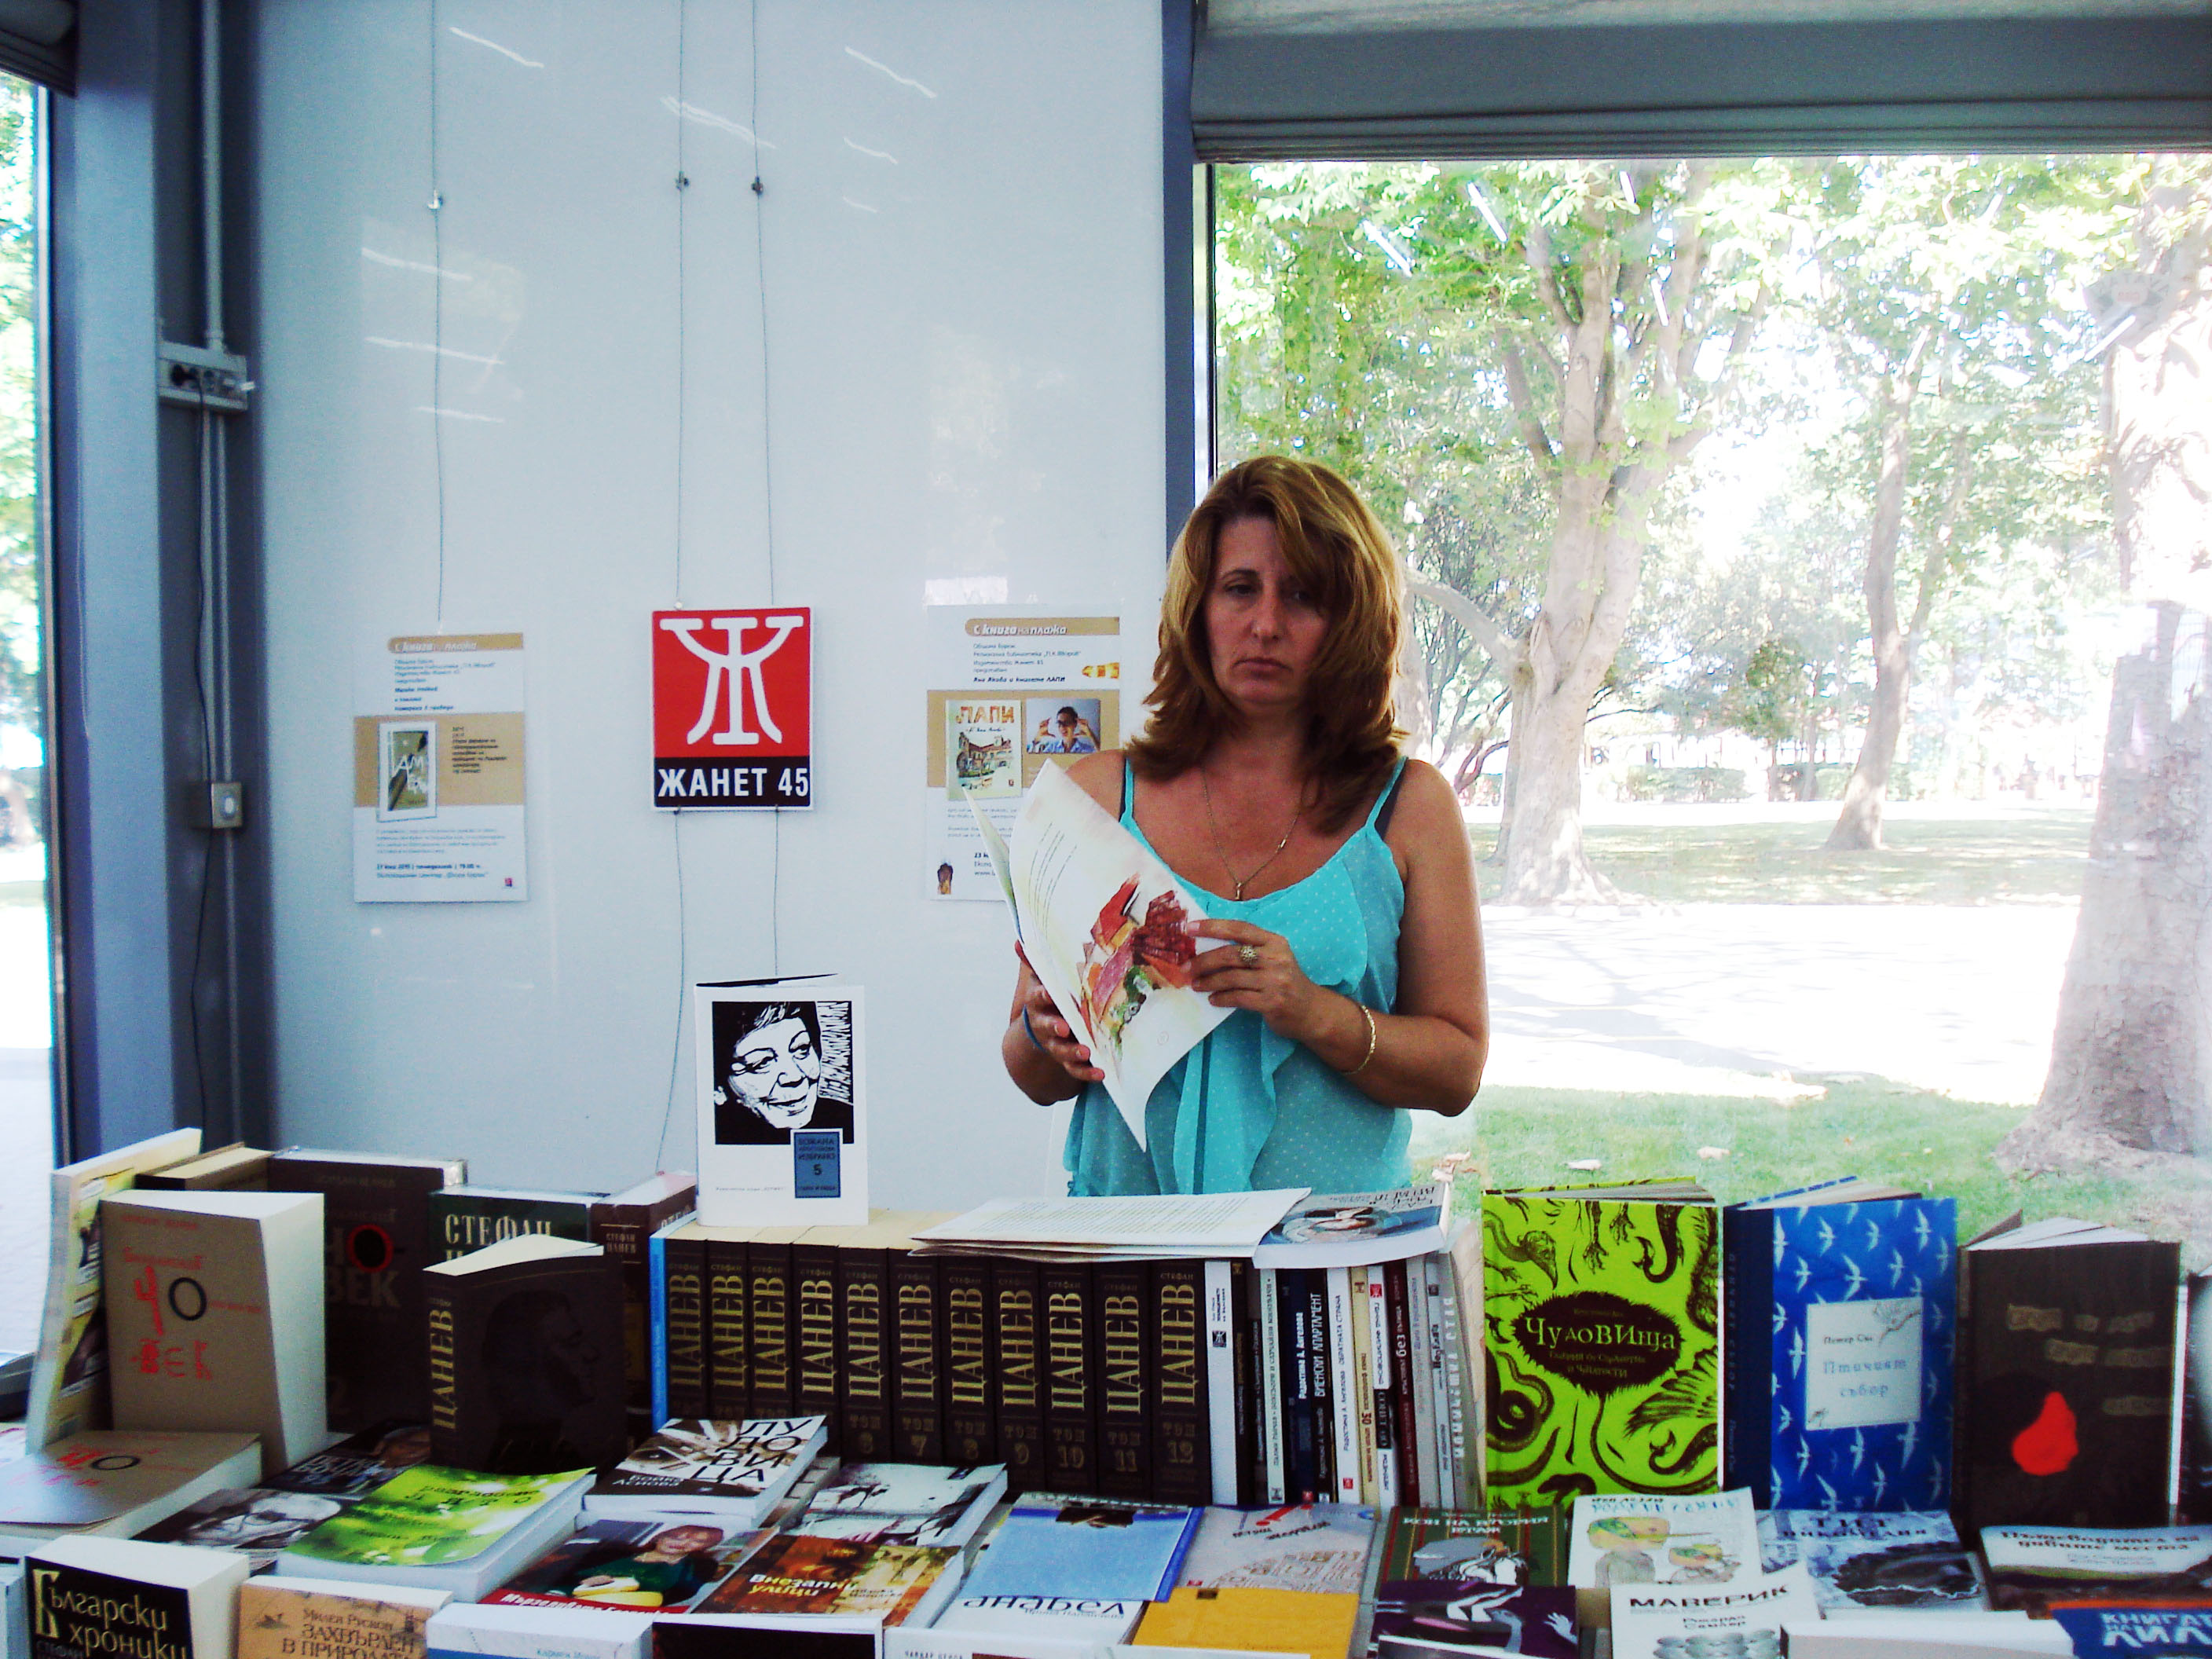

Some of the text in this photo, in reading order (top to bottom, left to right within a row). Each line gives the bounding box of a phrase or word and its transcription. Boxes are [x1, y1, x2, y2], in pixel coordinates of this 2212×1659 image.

[1031, 624, 1068, 635] плажа
[955, 705, 1015, 724] ЛАПИ
[657, 767, 809, 797] ЖАНЕТ 45
[813, 1163, 822, 1176] 5
[670, 1275, 705, 1389] ЦАНЕВ
[712, 1276, 748, 1389] ЦАНЕВ
[753, 1276, 790, 1390] ЦАНЕВ
[800, 1280, 837, 1395] ЦАНЕВ
[848, 1283, 884, 1400] ЦАНЕВ
[899, 1284, 937, 1401] ЦАНЕВ
[950, 1287, 987, 1405] ЦАНЕВ
[999, 1289, 1040, 1408] ЦАНЕВ
[1049, 1292, 1088, 1412] ЦАНЕВ
[1160, 1284, 1199, 1407] ЦАНЕВ
[1310, 1292, 1324, 1351] АПАРТАМЕНТ
[1395, 1333, 1407, 1358] без
[1443, 1298, 1457, 1341] СТАЯ
[428, 1309, 458, 1431] ЦАНЕВ
[1104, 1295, 1144, 1414] ЦАНЕВ
[32, 1568, 168, 1639] Български
[747, 1584, 821, 1598] улици
[963, 1595, 1125, 1615] анабел
[1629, 1584, 1789, 1608] МАВЕРИК
[68, 1622, 189, 1659] хроники
[281, 1637, 408, 1659] В ПРИРОД
[302, 1623, 415, 1654] ЗАХВЪРЛЕН
